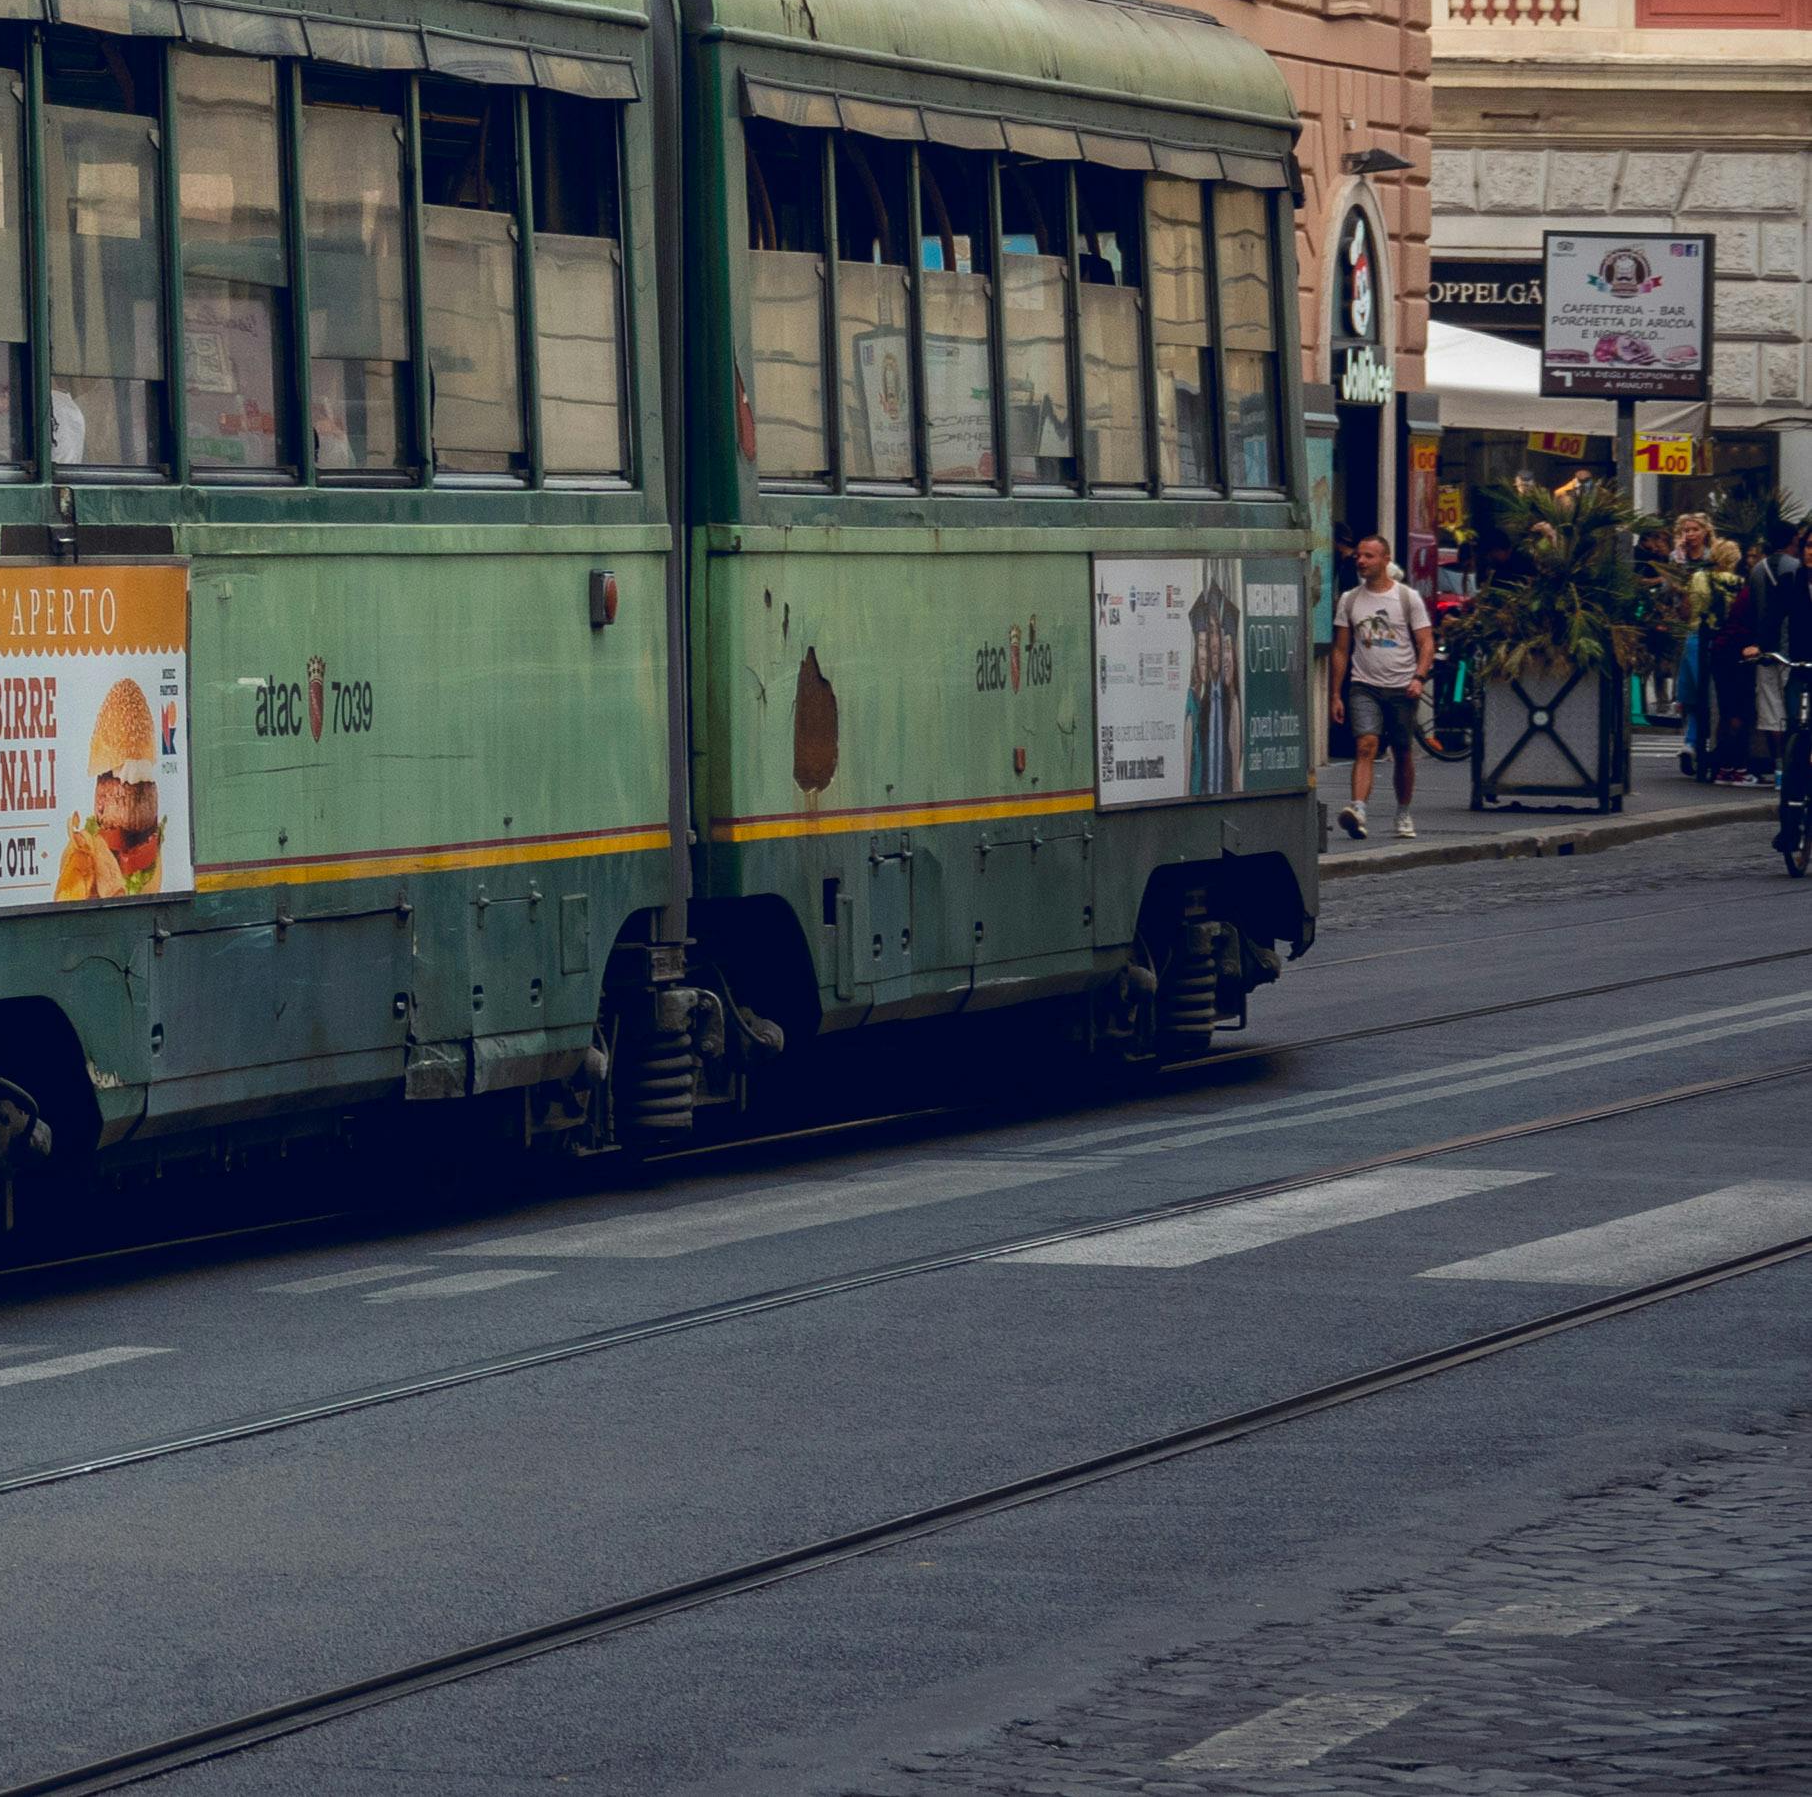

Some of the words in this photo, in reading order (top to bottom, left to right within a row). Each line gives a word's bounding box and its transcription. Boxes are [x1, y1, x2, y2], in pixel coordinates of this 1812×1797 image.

[1551, 316, 1625, 328] PORCHETTA
[1630, 317, 1643, 328] DI
[1646, 318, 1697, 329] ARICCIA
[1561, 303, 1643, 315] CAFFETTERIA
[1659, 305, 1686, 316] BAR
[1581, 329, 1590, 339] E
[976, 641, 1007, 693] atac
[1025, 641, 1053, 688] 7039
[255, 675, 304, 738] atac
[331, 679, 374, 735] 7039
[6, 837, 39, 878] OTT.
